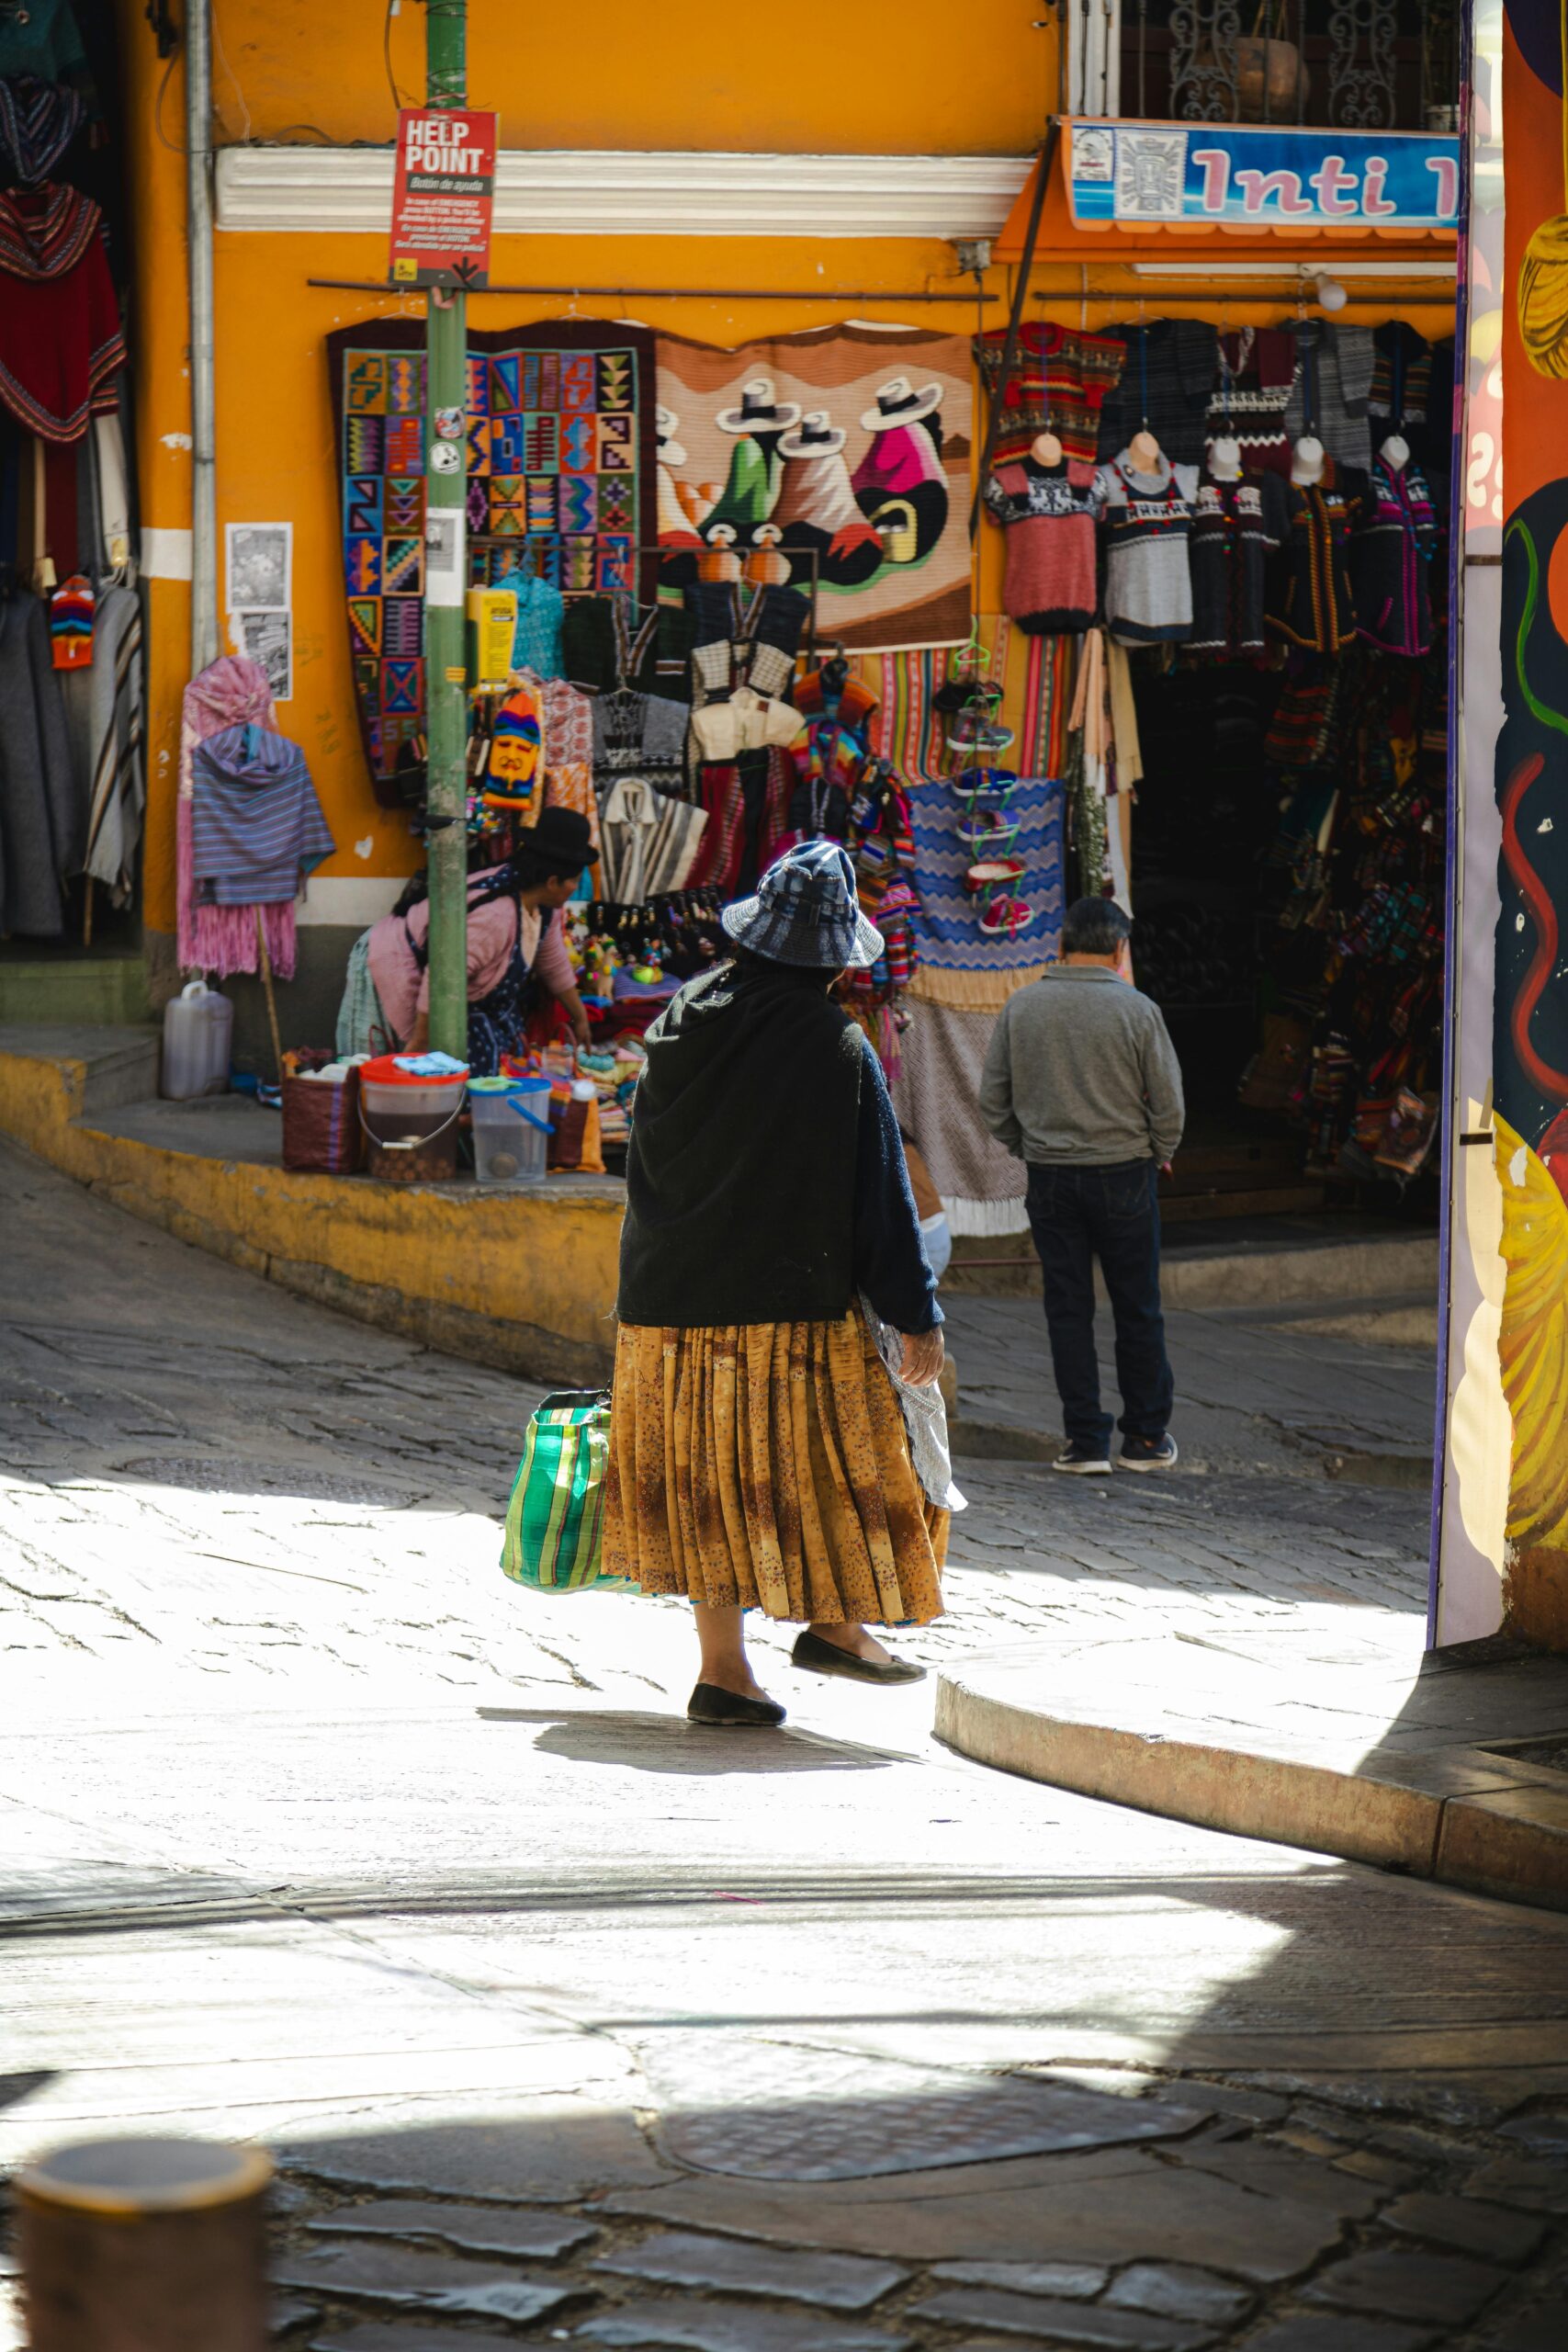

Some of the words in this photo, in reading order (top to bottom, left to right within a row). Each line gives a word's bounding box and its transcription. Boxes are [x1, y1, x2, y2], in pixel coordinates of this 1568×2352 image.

[406, 119, 469, 147] HELP
[404, 145, 484, 174] POINT
[1192, 149, 1396, 217] Inti
